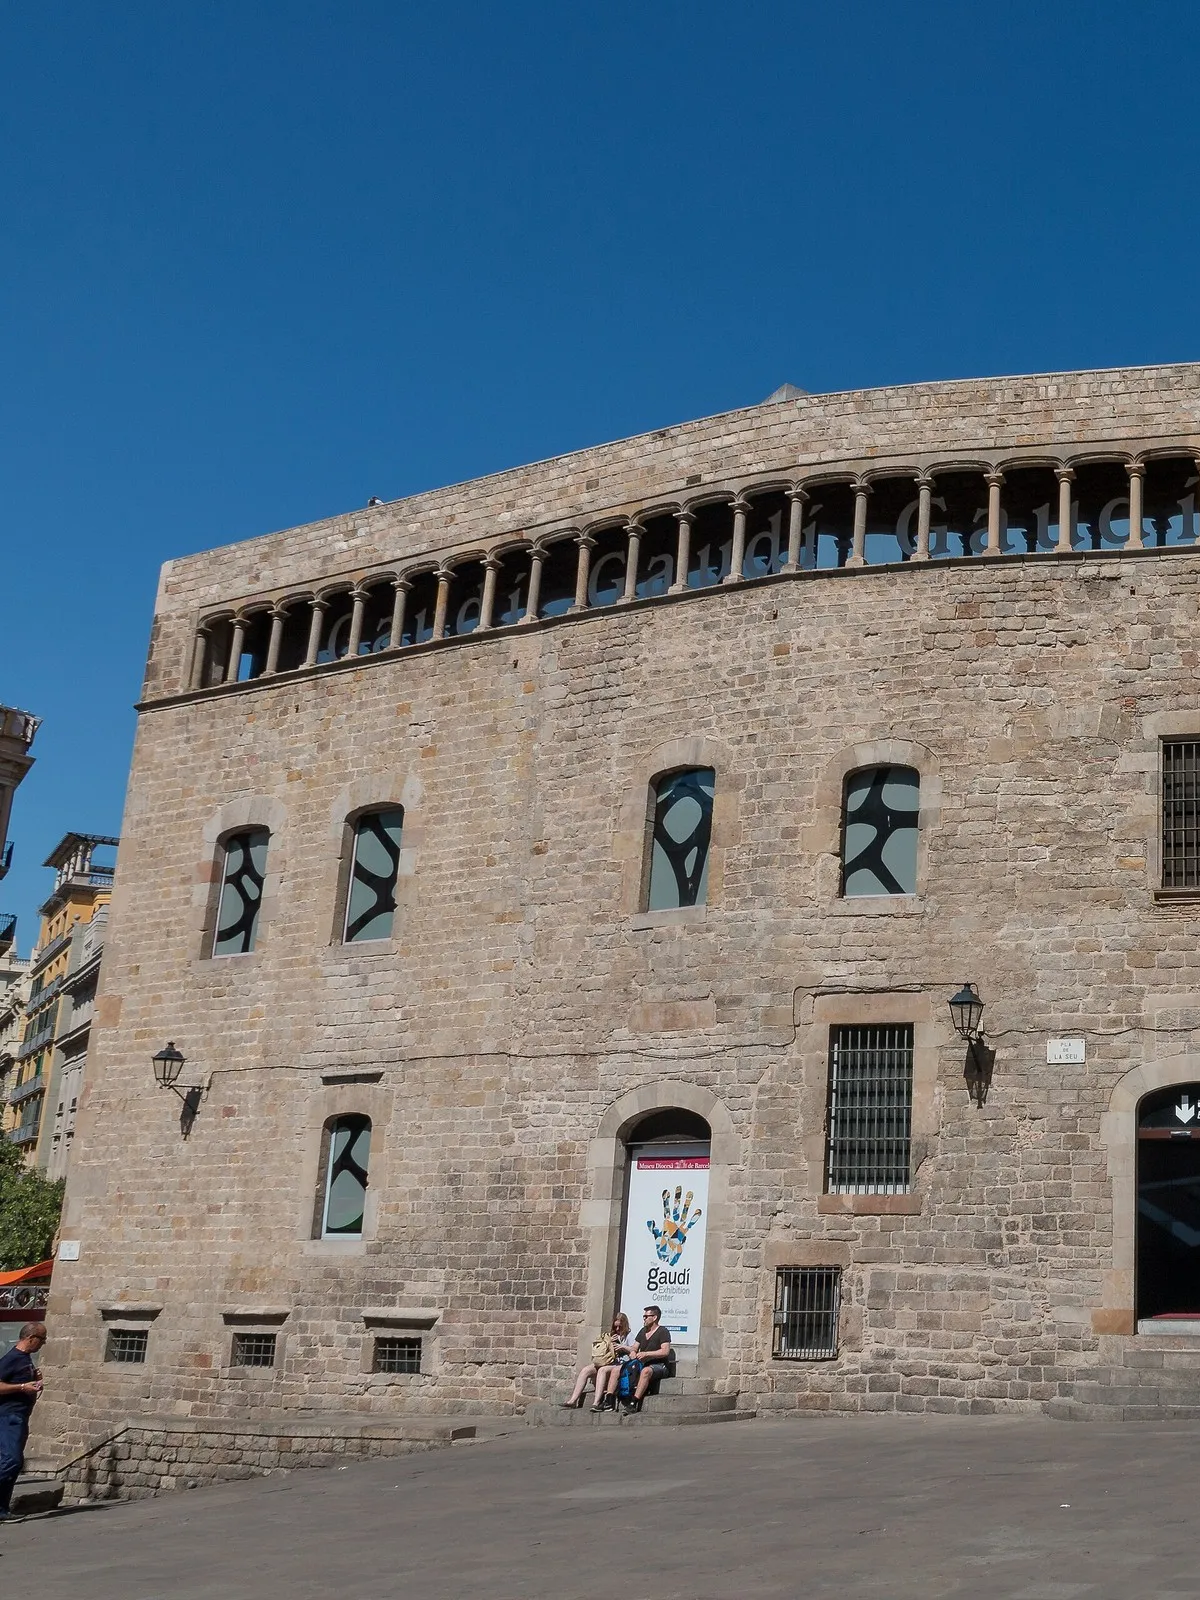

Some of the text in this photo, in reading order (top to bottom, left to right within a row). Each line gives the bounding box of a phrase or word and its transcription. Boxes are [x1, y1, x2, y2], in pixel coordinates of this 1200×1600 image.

[896, 476, 1200, 559] Gaudí
[588, 504, 824, 608] Gaudí
[647, 1267, 690, 1291] gaudí
[658, 1286, 690, 1295] Exhibition
[652, 1293, 674, 1301] Center
